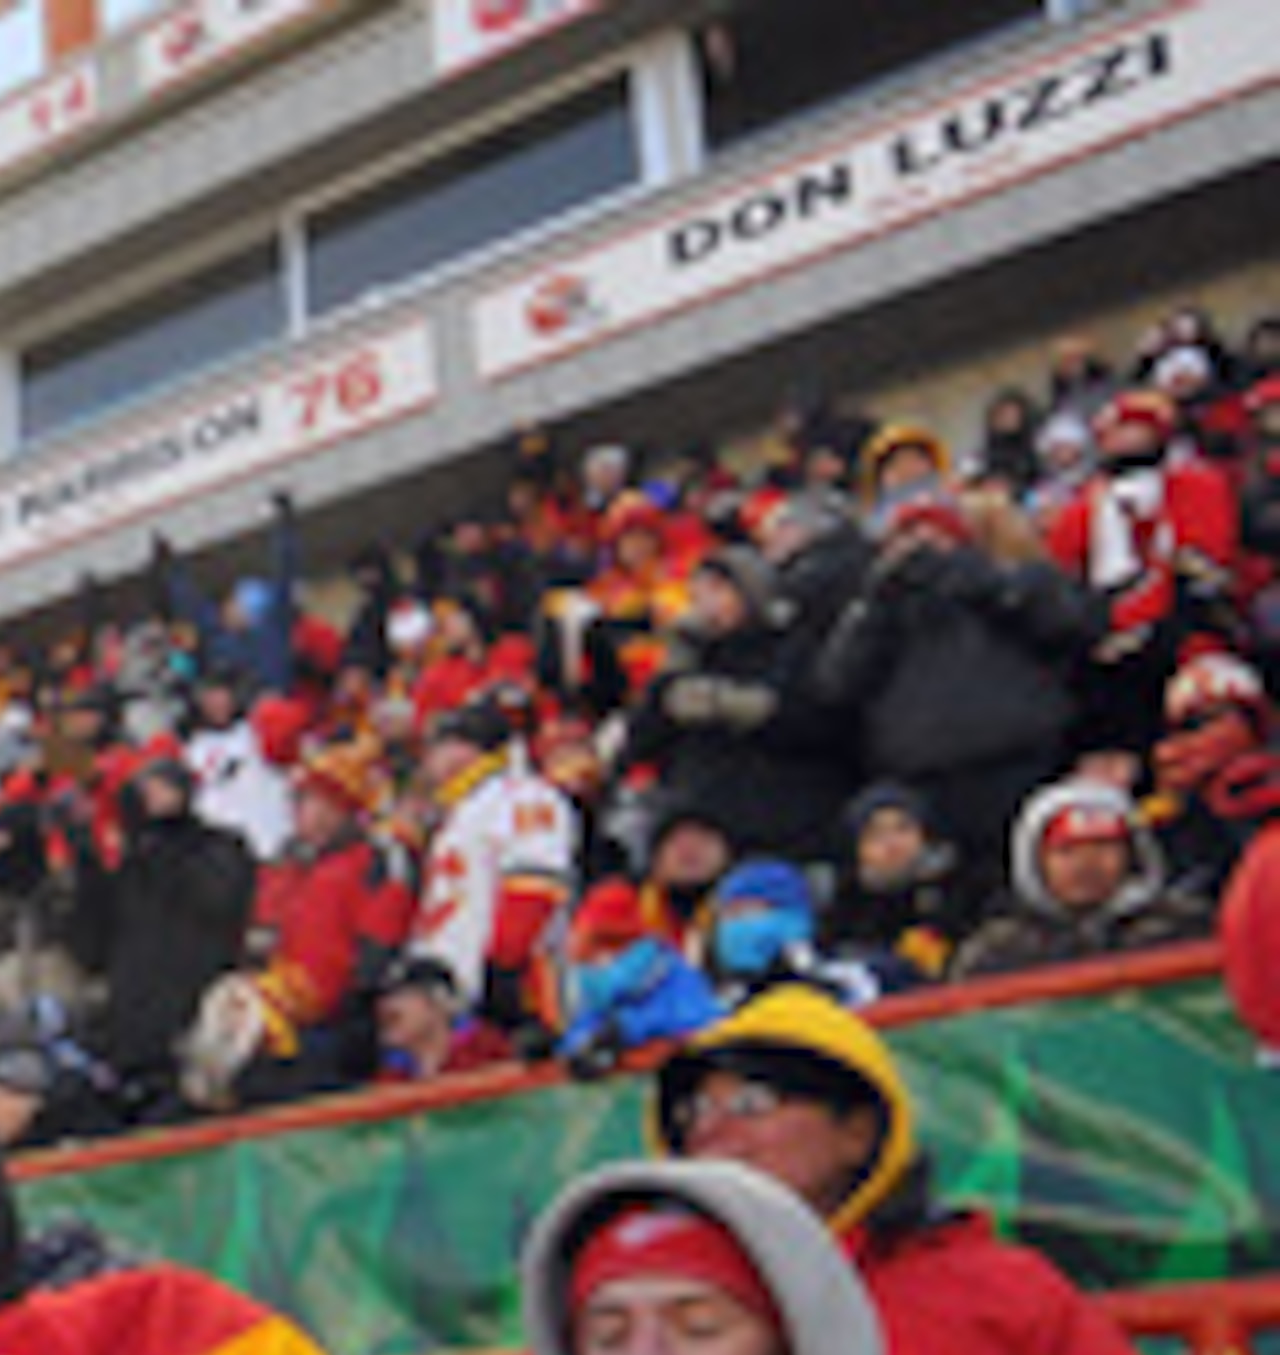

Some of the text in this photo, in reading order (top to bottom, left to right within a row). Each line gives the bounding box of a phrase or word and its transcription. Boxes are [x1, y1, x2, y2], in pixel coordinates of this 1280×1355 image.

[667, 163, 853, 266] DON
[889, 31, 1173, 177] LUZZI
[17, 400, 262, 525] HARRISON
[289, 350, 383, 430] 76
